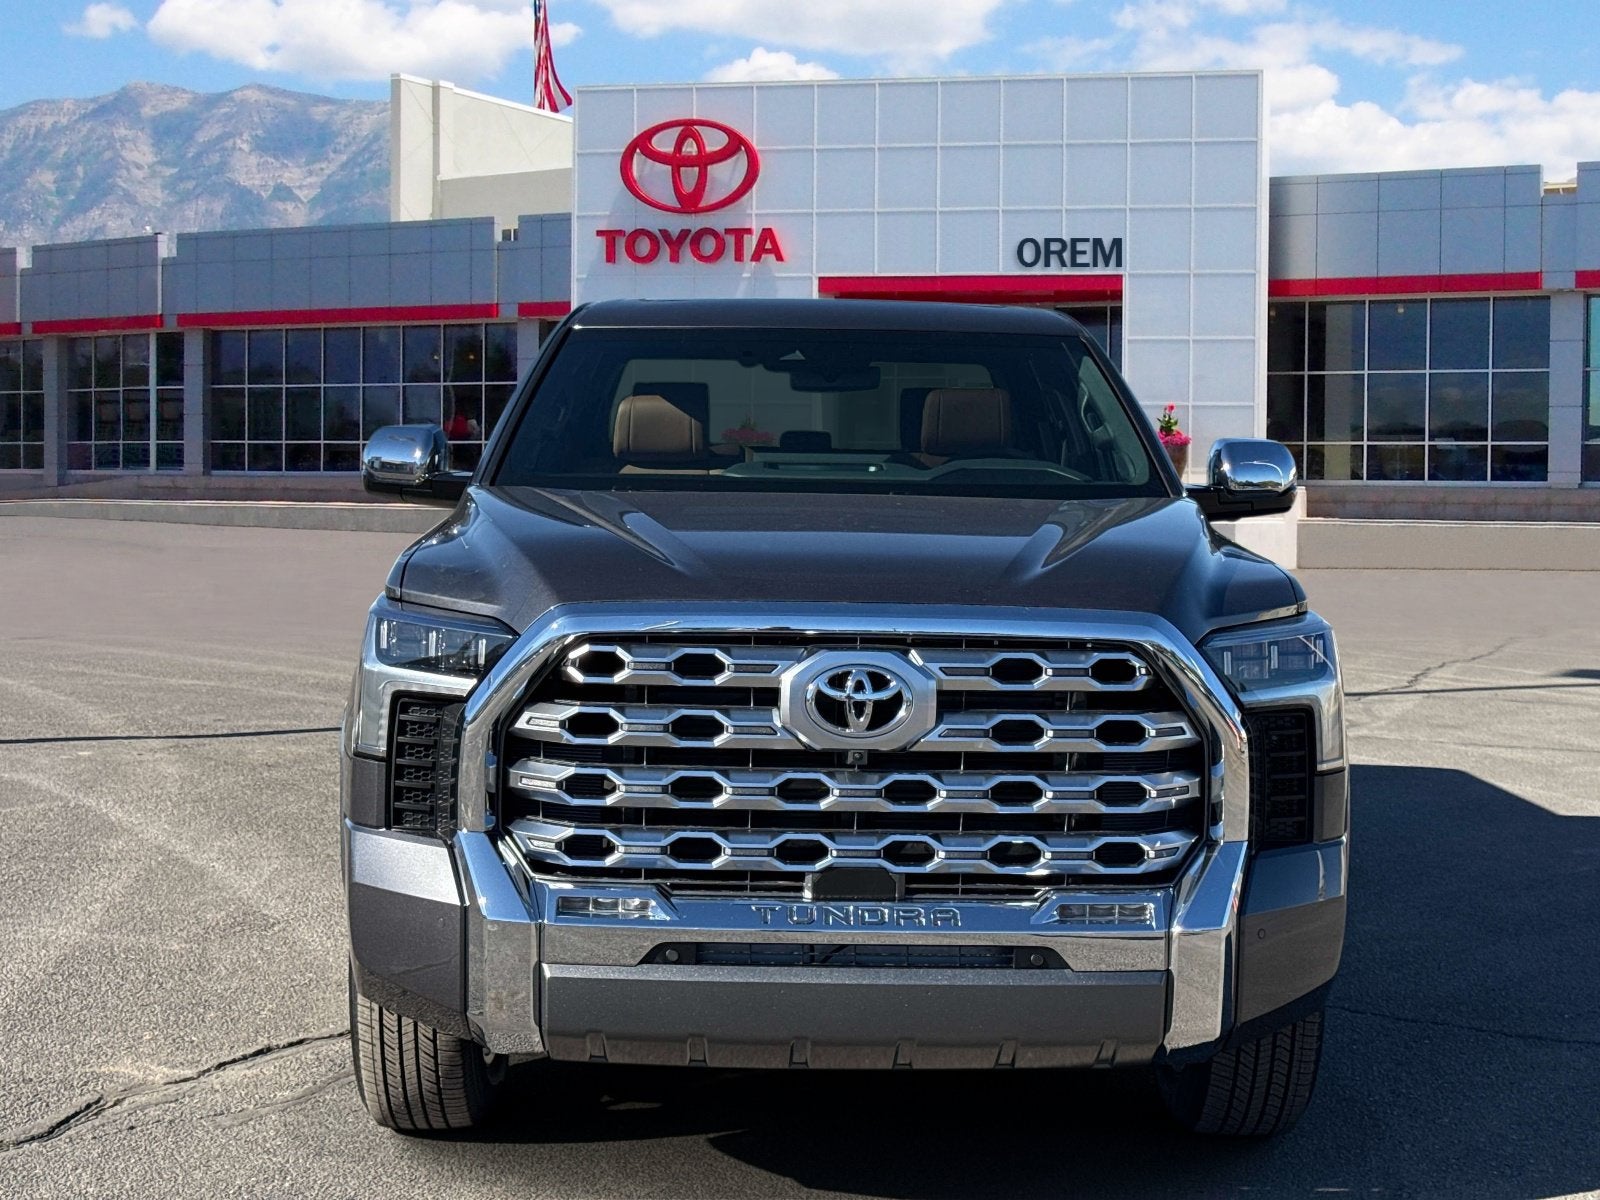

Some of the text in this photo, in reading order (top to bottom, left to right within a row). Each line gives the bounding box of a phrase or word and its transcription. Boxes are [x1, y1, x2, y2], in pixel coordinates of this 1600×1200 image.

[596, 227, 785, 264] TOYOTA
[1016, 238, 1122, 268] OREM
[751, 905, 962, 927] TUNDRA
